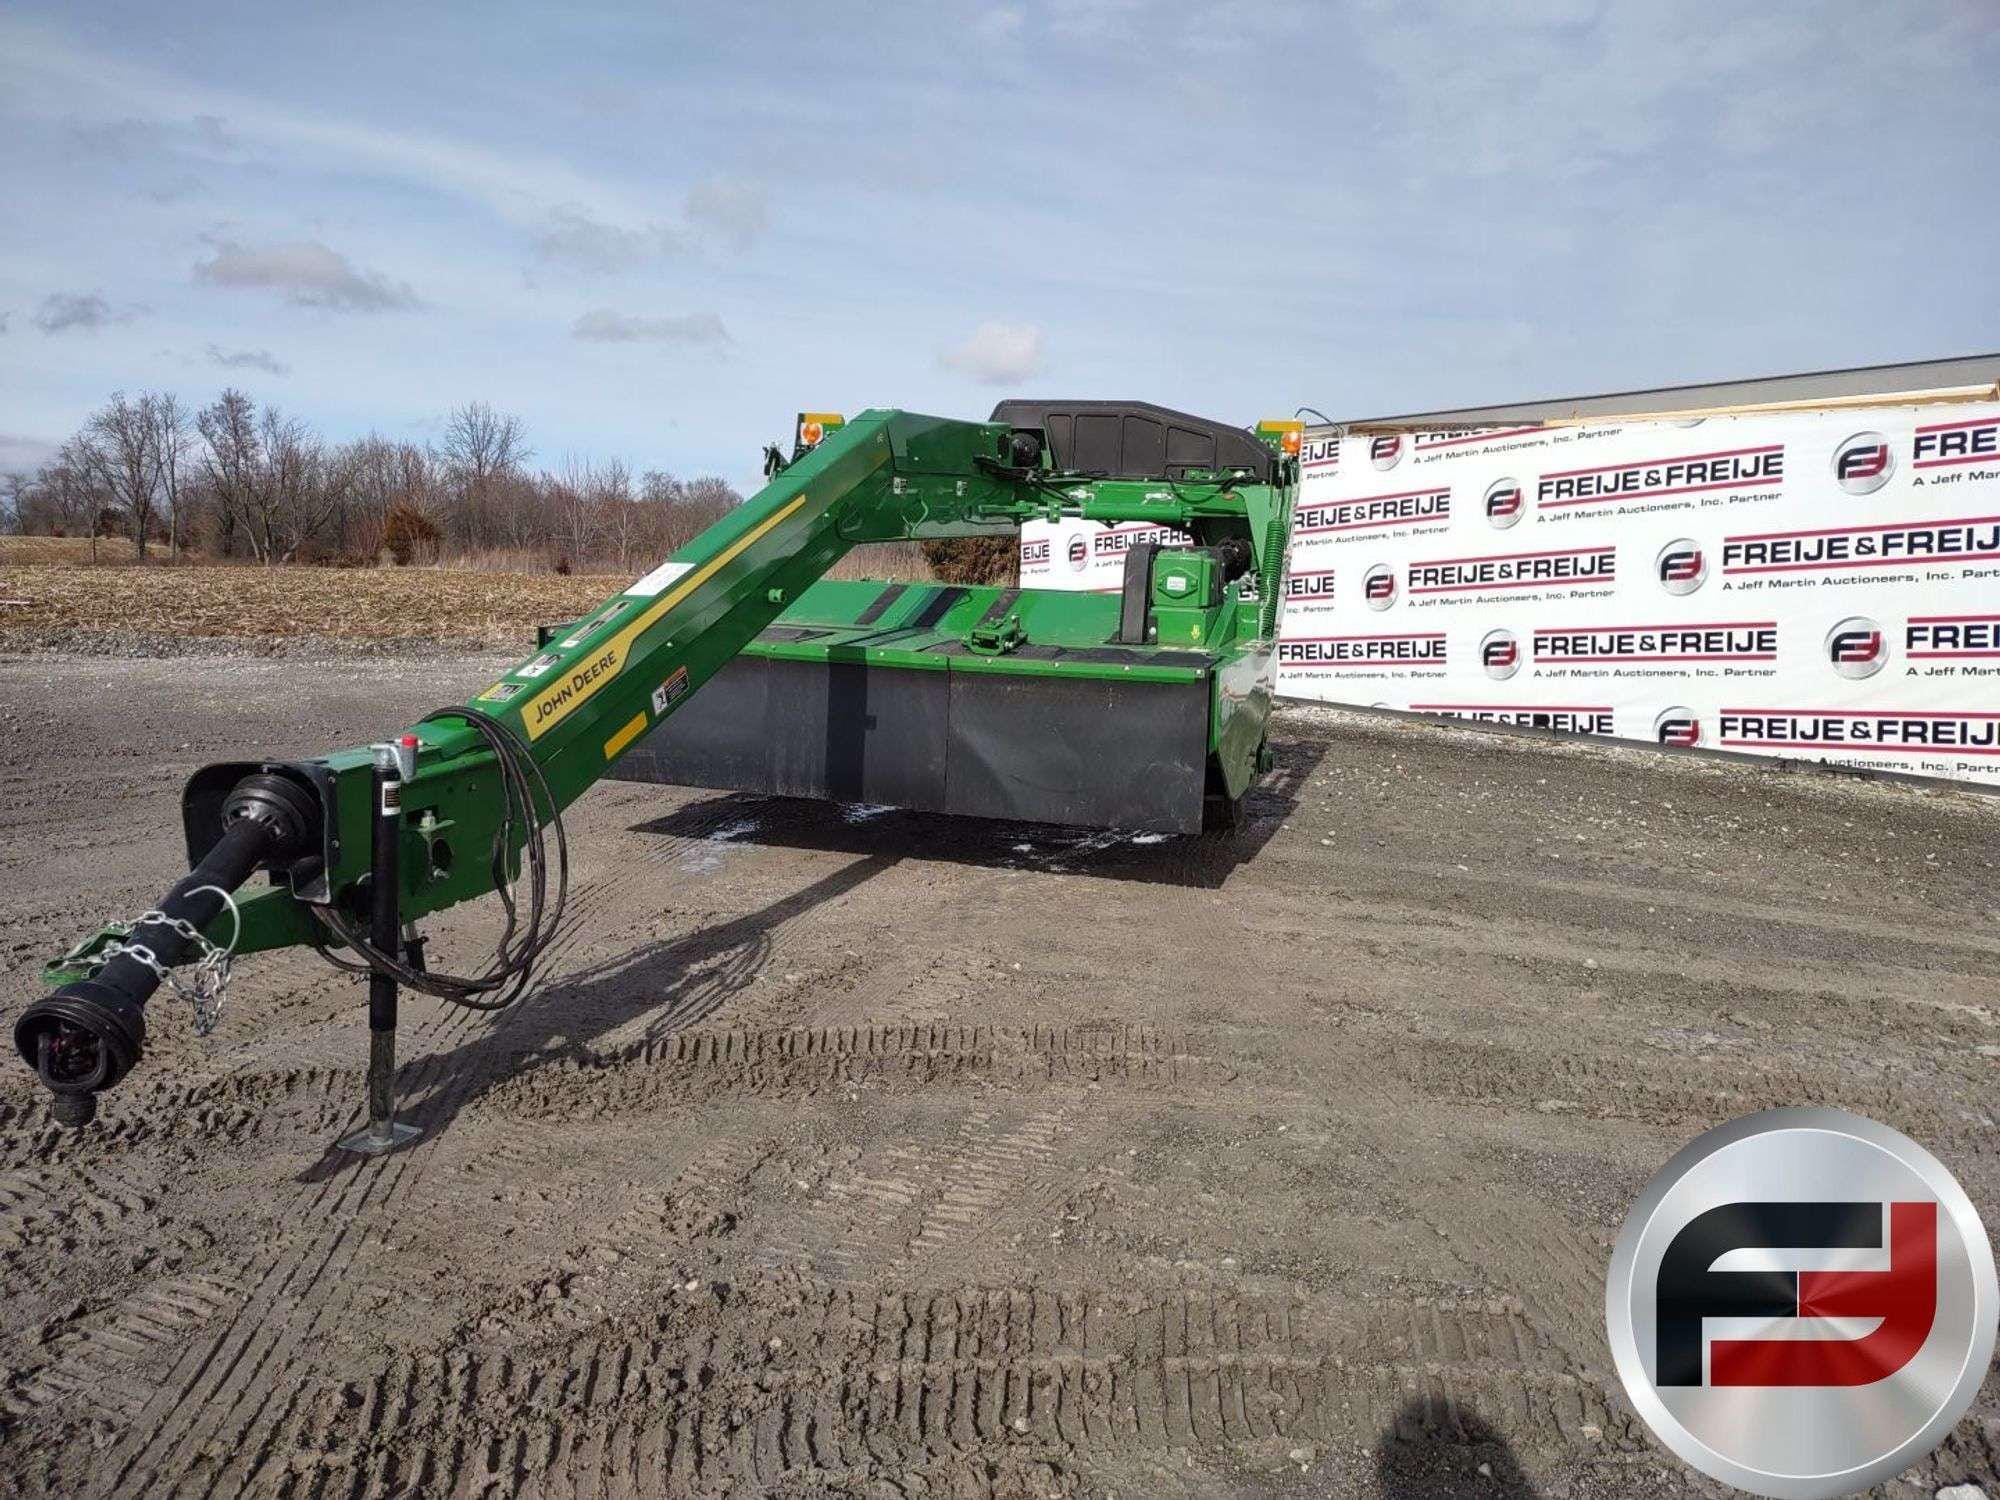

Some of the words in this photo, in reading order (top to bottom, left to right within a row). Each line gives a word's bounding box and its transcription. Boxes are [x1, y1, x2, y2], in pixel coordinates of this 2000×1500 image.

[1301, 441, 1340, 462] EIJE
[1424, 454, 1442, 463] Jeff
[1446, 449, 1478, 460] Martin
[1482, 439, 1549, 455] Auctioneers,
[1553, 434, 1573, 443] Inc.
[1577, 427, 1623, 441] Partner
[1913, 427, 2000, 460] FRE
[1912, 477, 1925, 487] A
[1931, 472, 1962, 485] Jeff
[1969, 469, 2000, 481] Mar
[1294, 507, 1351, 529] REIJE
[1537, 515, 1546, 523] A
[1549, 512, 1570, 522] Jeff
[1574, 508, 1613, 519] Martin
[1617, 500, 1695, 515] Auctioneers,
[1701, 498, 1723, 507] Inc.
[1729, 492, 1783, 504] Partner
[1293, 541, 1303, 549] eff
[1306, 537, 1333, 547] Martin
[1412, 526, 1450, 536] Partner
[1882, 525, 2000, 556] FREIJ
[1022, 544, 1050, 560] EIJE
[1722, 582, 1733, 591] A
[1738, 580, 1763, 591] Jeff
[1768, 577, 1816, 588] Martin
[1821, 574, 1919, 586] Auctioneers,
[1926, 571, 1955, 581] Inc.
[1962, 568, 2000, 579] Part
[1303, 605, 1334, 613] Partner
[1418, 598, 1437, 607] Jeff
[1440, 597, 1473, 606] Martin
[1476, 592, 1542, 604] Auctioneers,
[1546, 592, 1566, 600] Inc.
[1570, 589, 1615, 598] Partner
[1906, 624, 2000, 649] FREI
[1411, 671, 1447, 679] Partner
[1533, 669, 1542, 678] A
[1545, 669, 1567, 678] Jeff
[1570, 669, 1609, 678] Martin
[1613, 669, 1690, 678] Auctioneers,
[1696, 668, 1719, 676] Inc.
[1724, 668, 1777, 677] Partner
[1906, 667, 1918, 676] A
[1924, 667, 1956, 676] Jeff
[1962, 667, 2000, 676] Mart
[535, 685, 573, 724] JOHN
[572, 650, 617, 692] DEERE
[1877, 720, 2000, 745] FREIJ
[1921, 761, 1949, 771] Inc.
